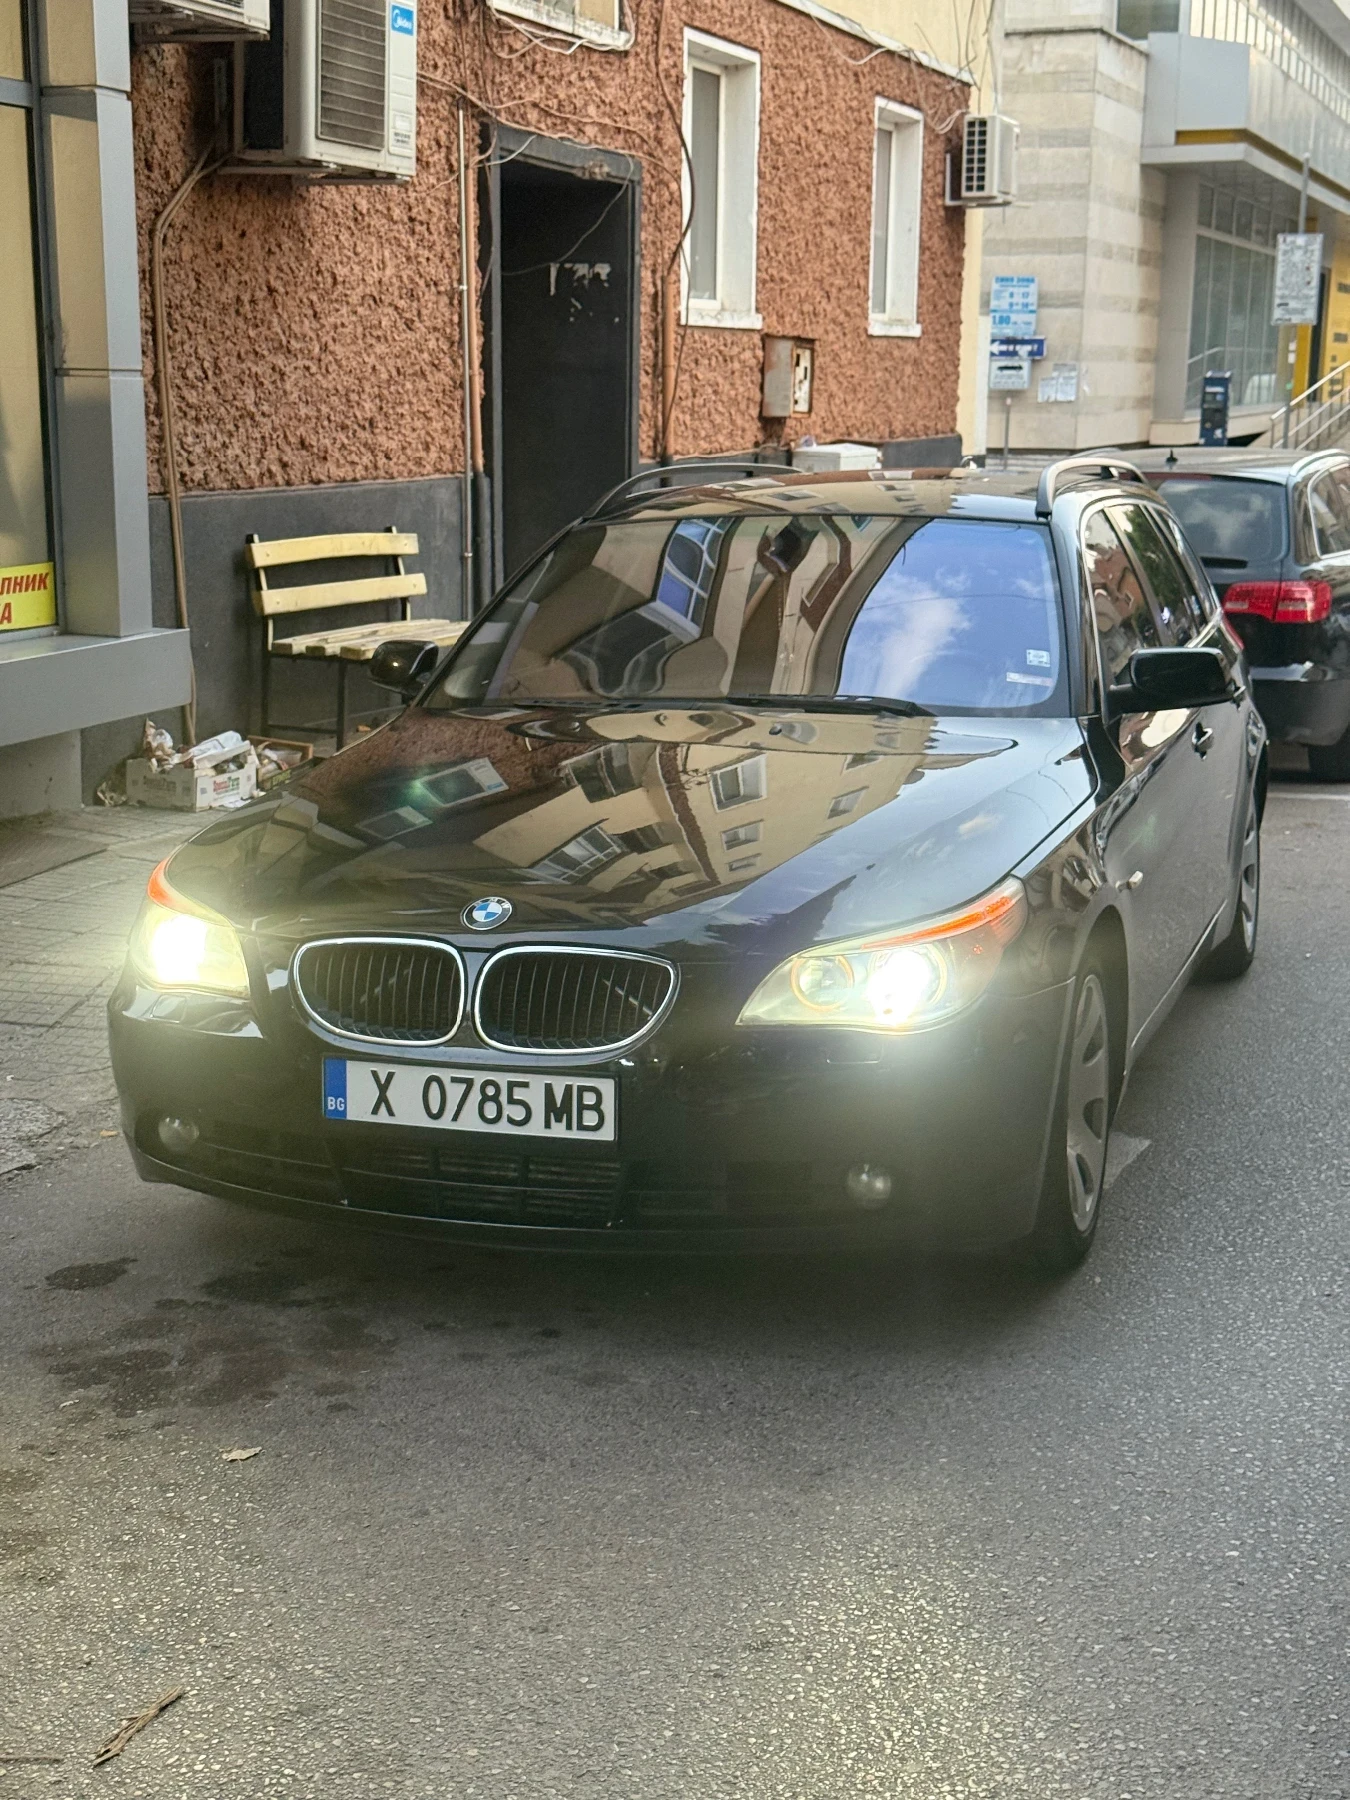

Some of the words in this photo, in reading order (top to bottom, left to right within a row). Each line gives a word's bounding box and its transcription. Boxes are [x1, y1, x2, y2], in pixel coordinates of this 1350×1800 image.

[327, 1096, 345, 1111] BG
[370, 1069, 396, 1117] X
[422, 1074, 532, 1127] 0785
[544, 1081, 605, 1132] MB
